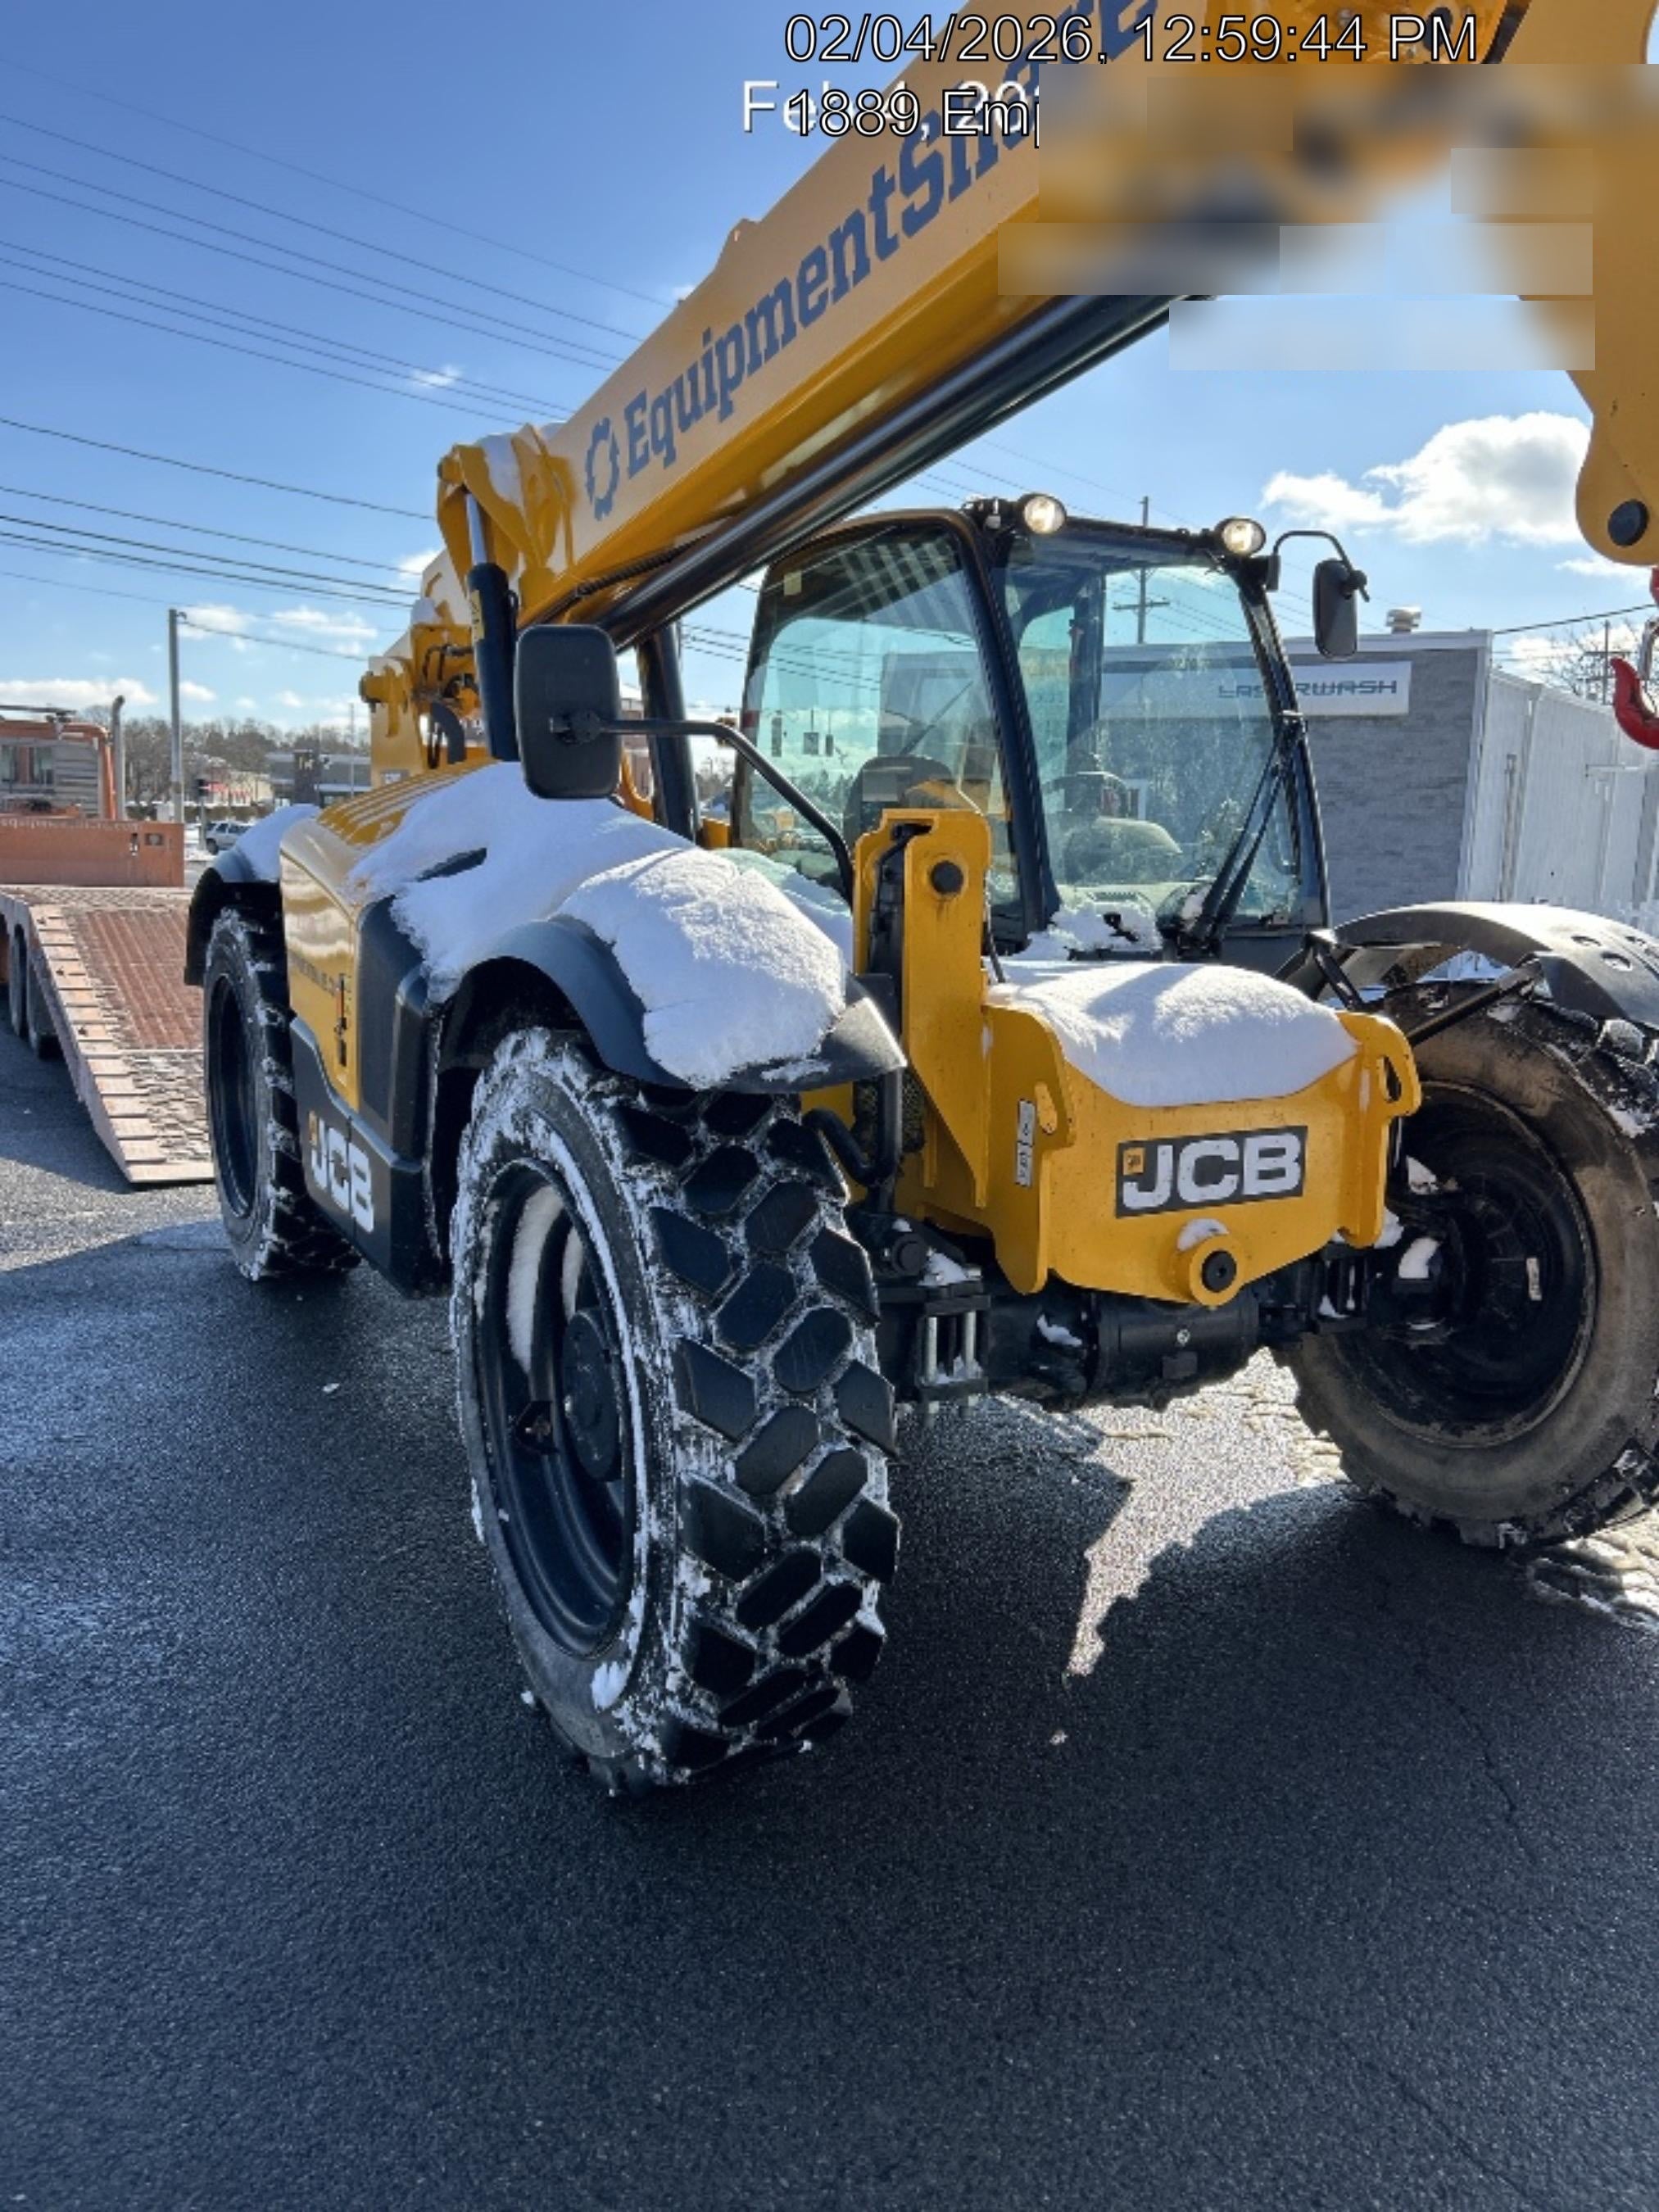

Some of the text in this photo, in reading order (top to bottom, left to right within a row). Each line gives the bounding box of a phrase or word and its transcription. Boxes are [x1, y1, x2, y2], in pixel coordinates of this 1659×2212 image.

[1218, 680, 1397, 699] LASRWASH
[311, 1117, 374, 1233] JCB
[1122, 1133, 1301, 1209] JCB
